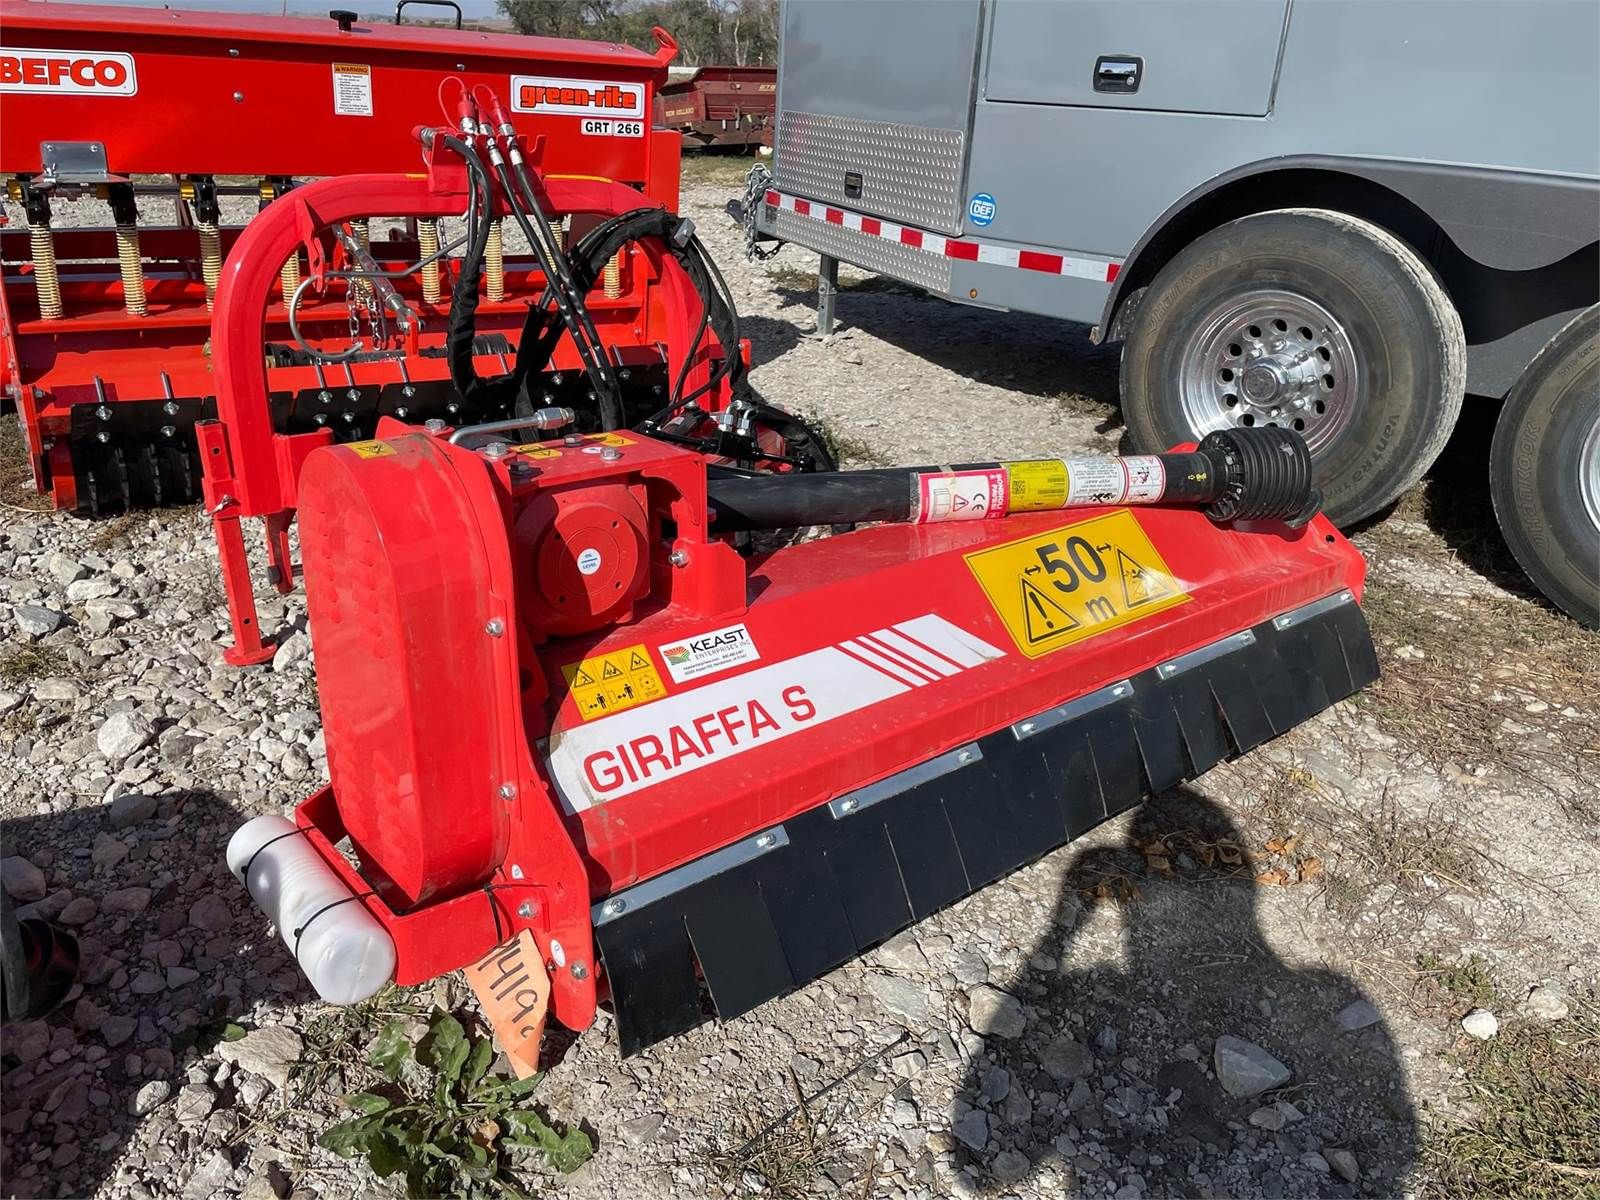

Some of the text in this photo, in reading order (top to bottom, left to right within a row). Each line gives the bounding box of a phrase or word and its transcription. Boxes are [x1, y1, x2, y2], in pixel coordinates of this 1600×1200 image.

[0, 56, 127, 87] BEFCO
[520, 85, 637, 109] green-rite
[585, 121, 640, 135] GRT 266
[974, 204, 991, 215] DEF
[1036, 535, 1107, 593] 50
[1085, 595, 1118, 622] m
[690, 628, 744, 653] KEAST
[695, 642, 739, 660] ENTERPRISES
[739, 639, 751, 648] INC
[583, 684, 817, 794] GIRAFFA S
